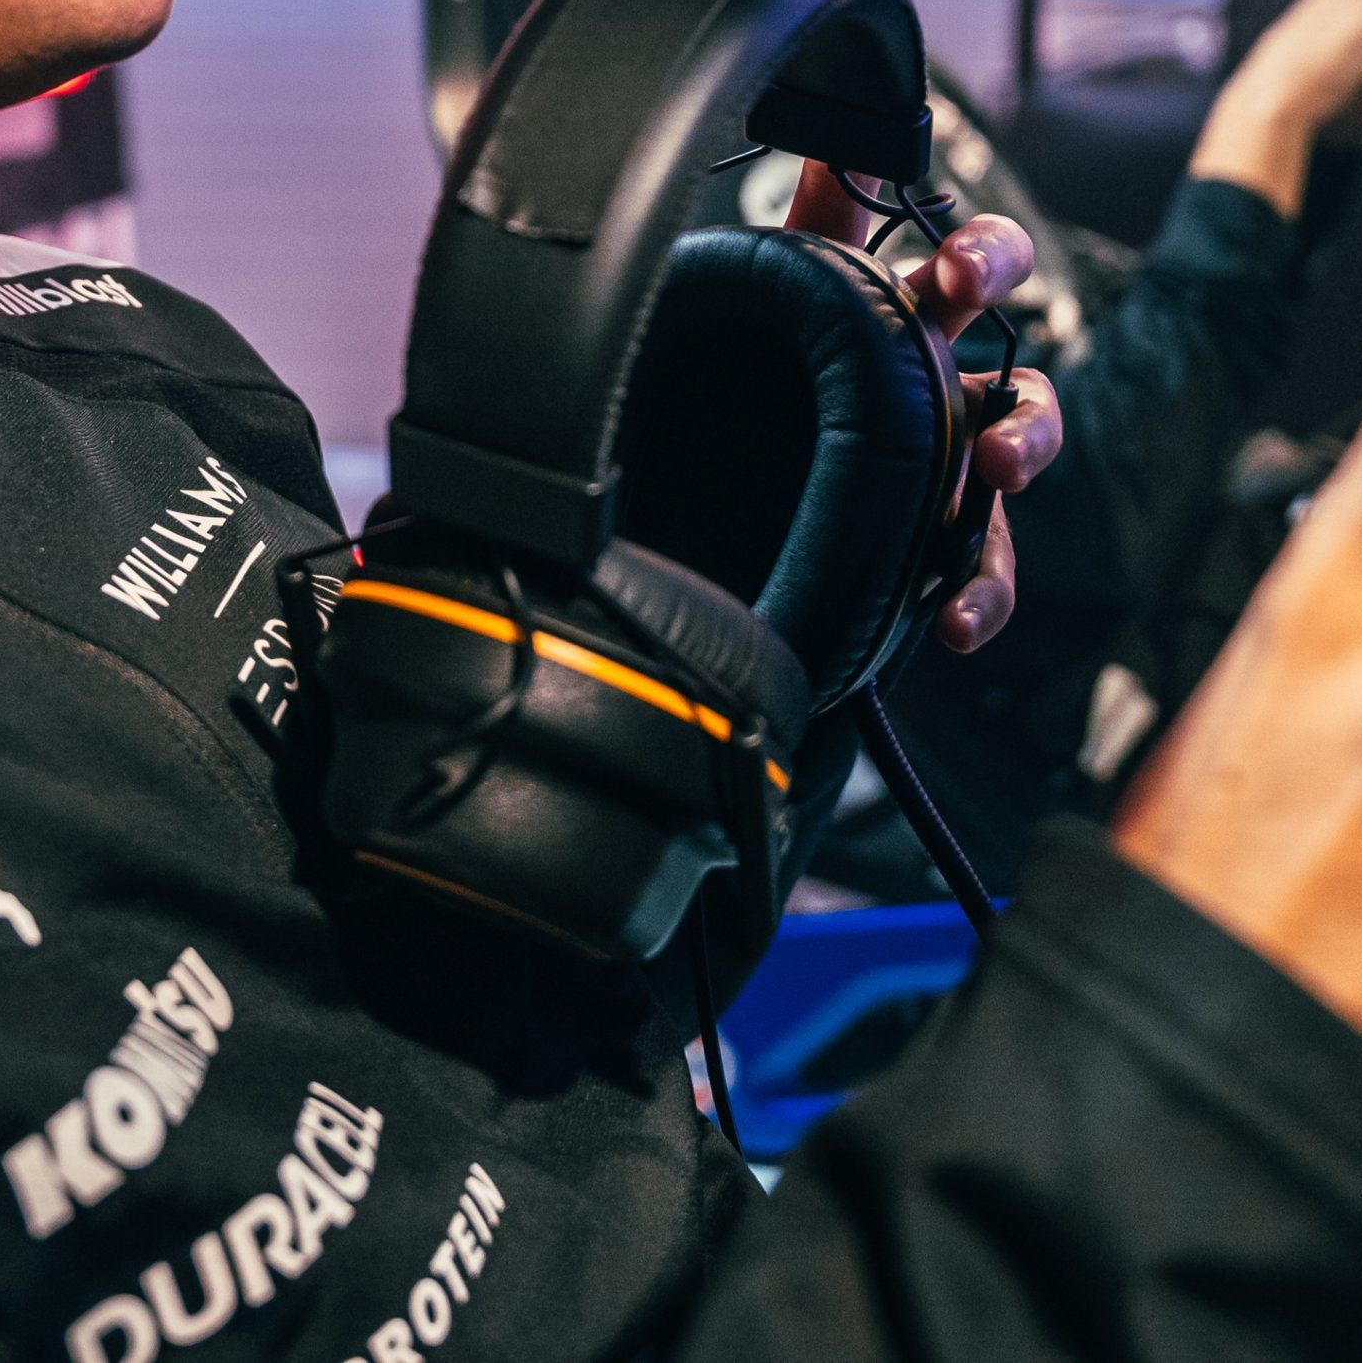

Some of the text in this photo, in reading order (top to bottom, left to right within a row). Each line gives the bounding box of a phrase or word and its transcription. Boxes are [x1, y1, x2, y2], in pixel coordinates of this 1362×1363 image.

[101, 457, 248, 621] WILLIAMS
[64, 1080, 384, 1363] DURACELL
[340, 1161, 506, 1363] ROTEIN
